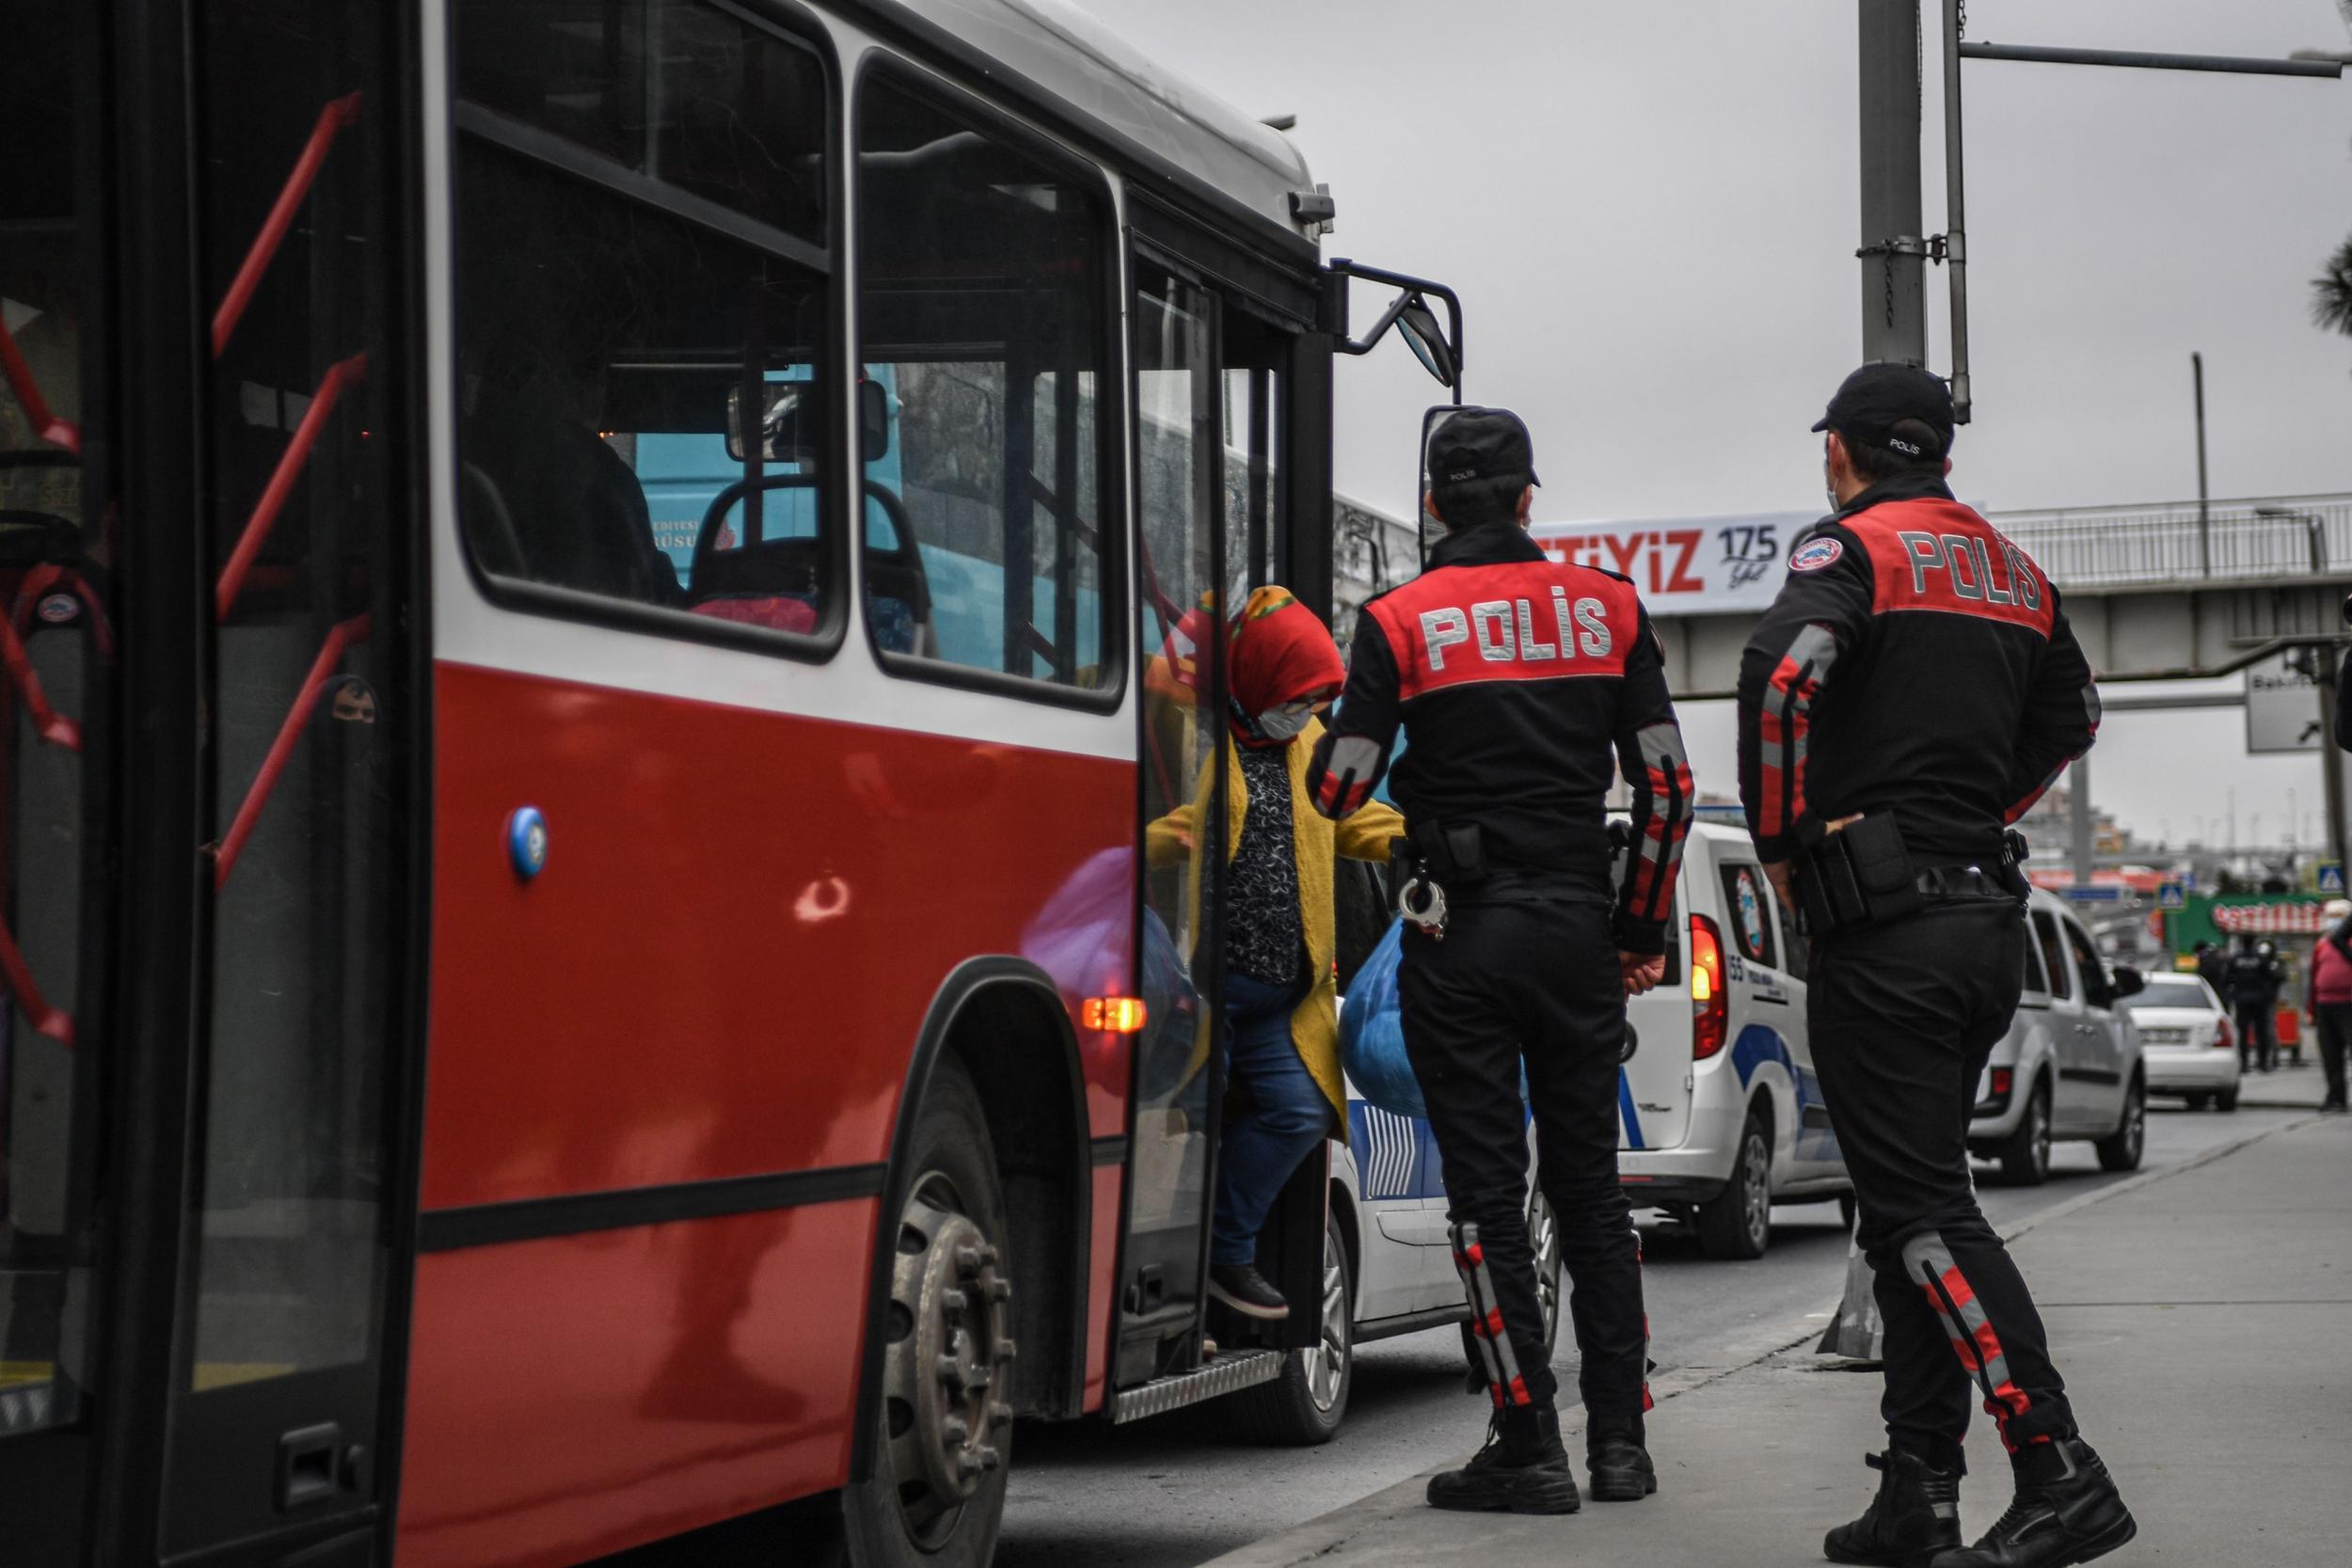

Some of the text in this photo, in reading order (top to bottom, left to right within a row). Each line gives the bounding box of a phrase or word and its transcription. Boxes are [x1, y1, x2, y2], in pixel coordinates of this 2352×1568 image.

[1537, 529, 1705, 594] TİYİZ
[1718, 524, 1779, 562] 175
[1897, 531, 2041, 611] POLİS
[1419, 585, 1613, 671] POLİS
